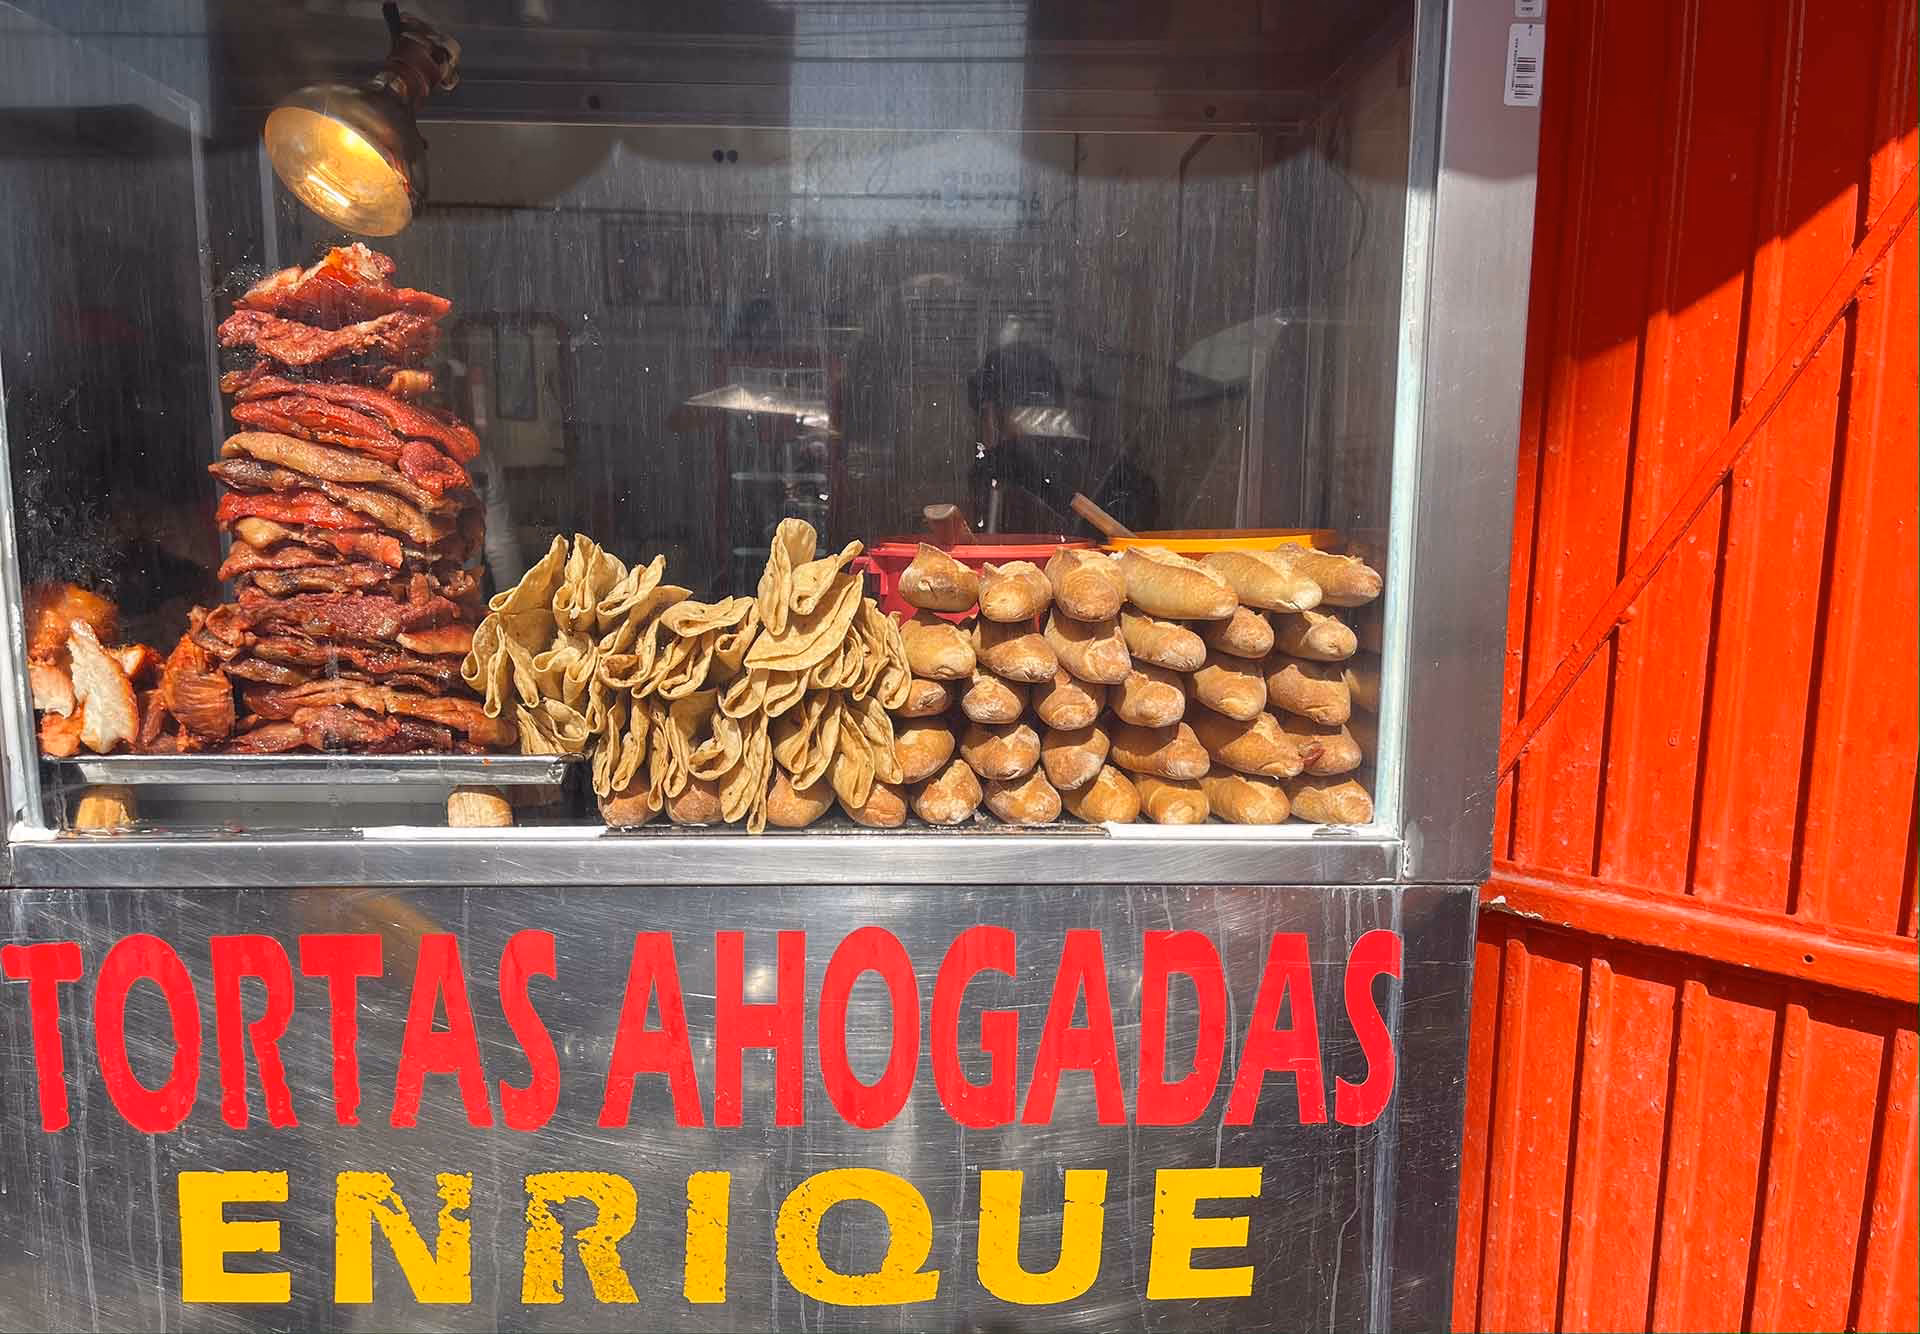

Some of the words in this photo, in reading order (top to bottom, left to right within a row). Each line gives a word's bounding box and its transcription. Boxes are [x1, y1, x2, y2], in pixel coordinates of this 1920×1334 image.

[2, 929, 561, 1133] TORTAS
[598, 925, 1402, 1130] AHOGADAS
[178, 1167, 1263, 1306] ENRIQUE
